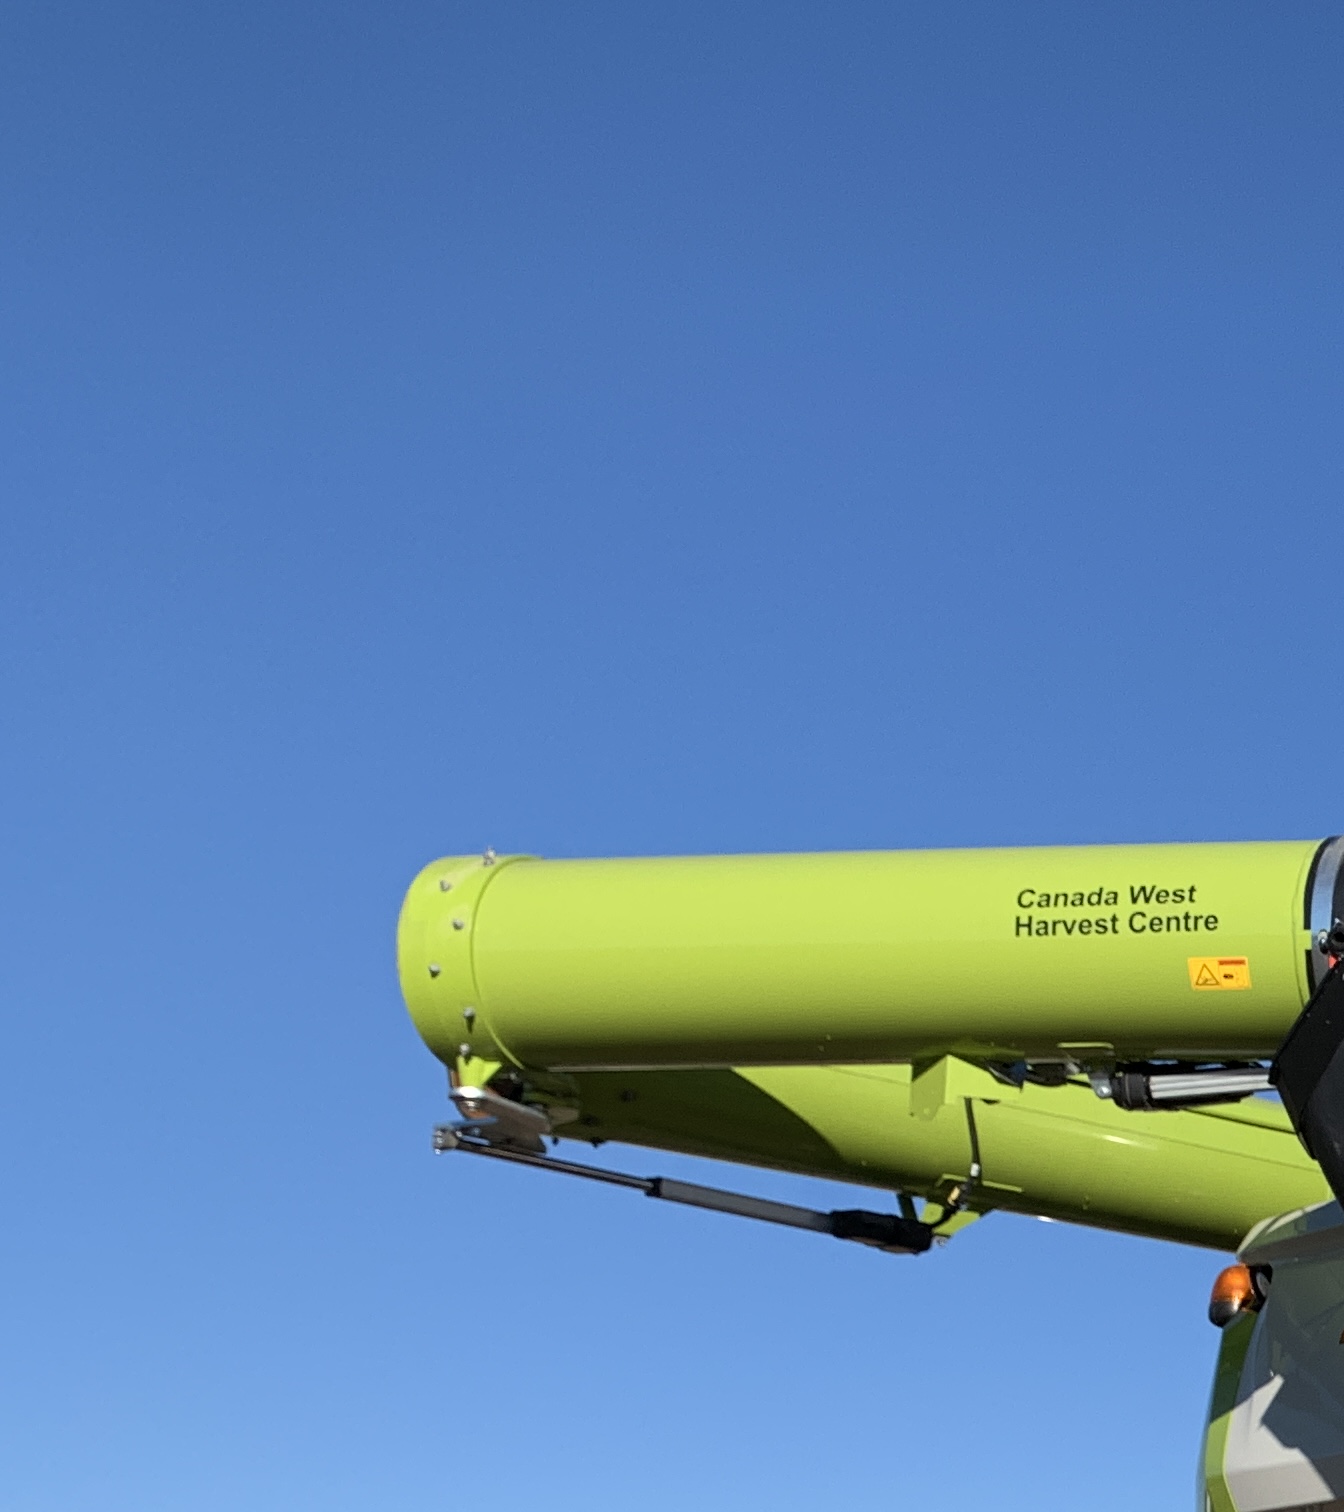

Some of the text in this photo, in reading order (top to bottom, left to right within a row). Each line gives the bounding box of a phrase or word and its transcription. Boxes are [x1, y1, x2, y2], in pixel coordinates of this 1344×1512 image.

[1016, 884, 1197, 909] Canada West
[1014, 911, 1219, 937] Harvest Centre
